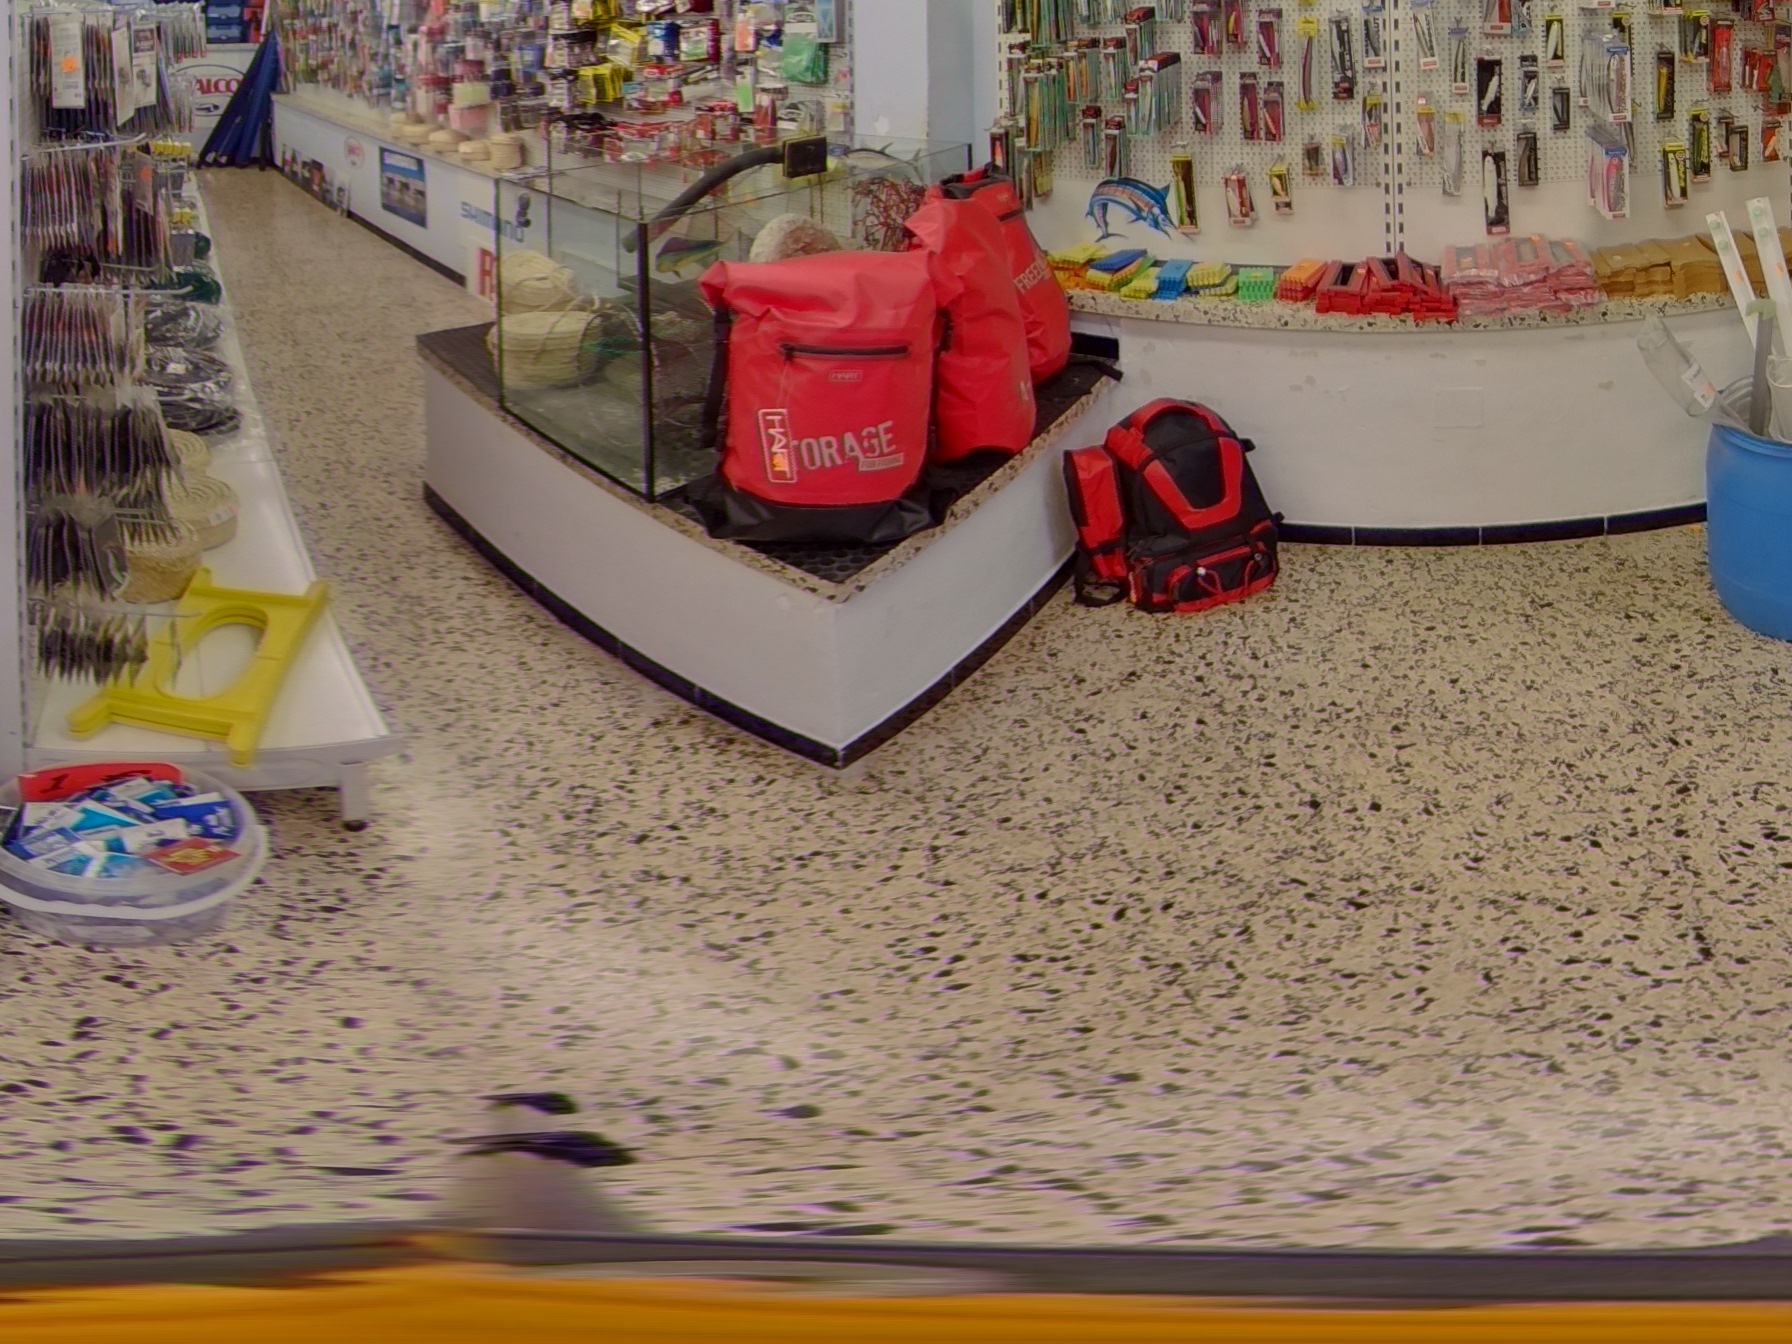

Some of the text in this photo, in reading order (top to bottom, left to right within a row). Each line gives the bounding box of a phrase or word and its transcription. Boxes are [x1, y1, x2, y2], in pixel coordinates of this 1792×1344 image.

[195, 78, 246, 94] ALCO
[460, 201, 525, 243] SHIMNO
[766, 416, 792, 479] HAT
[791, 420, 897, 470] ORAGE
